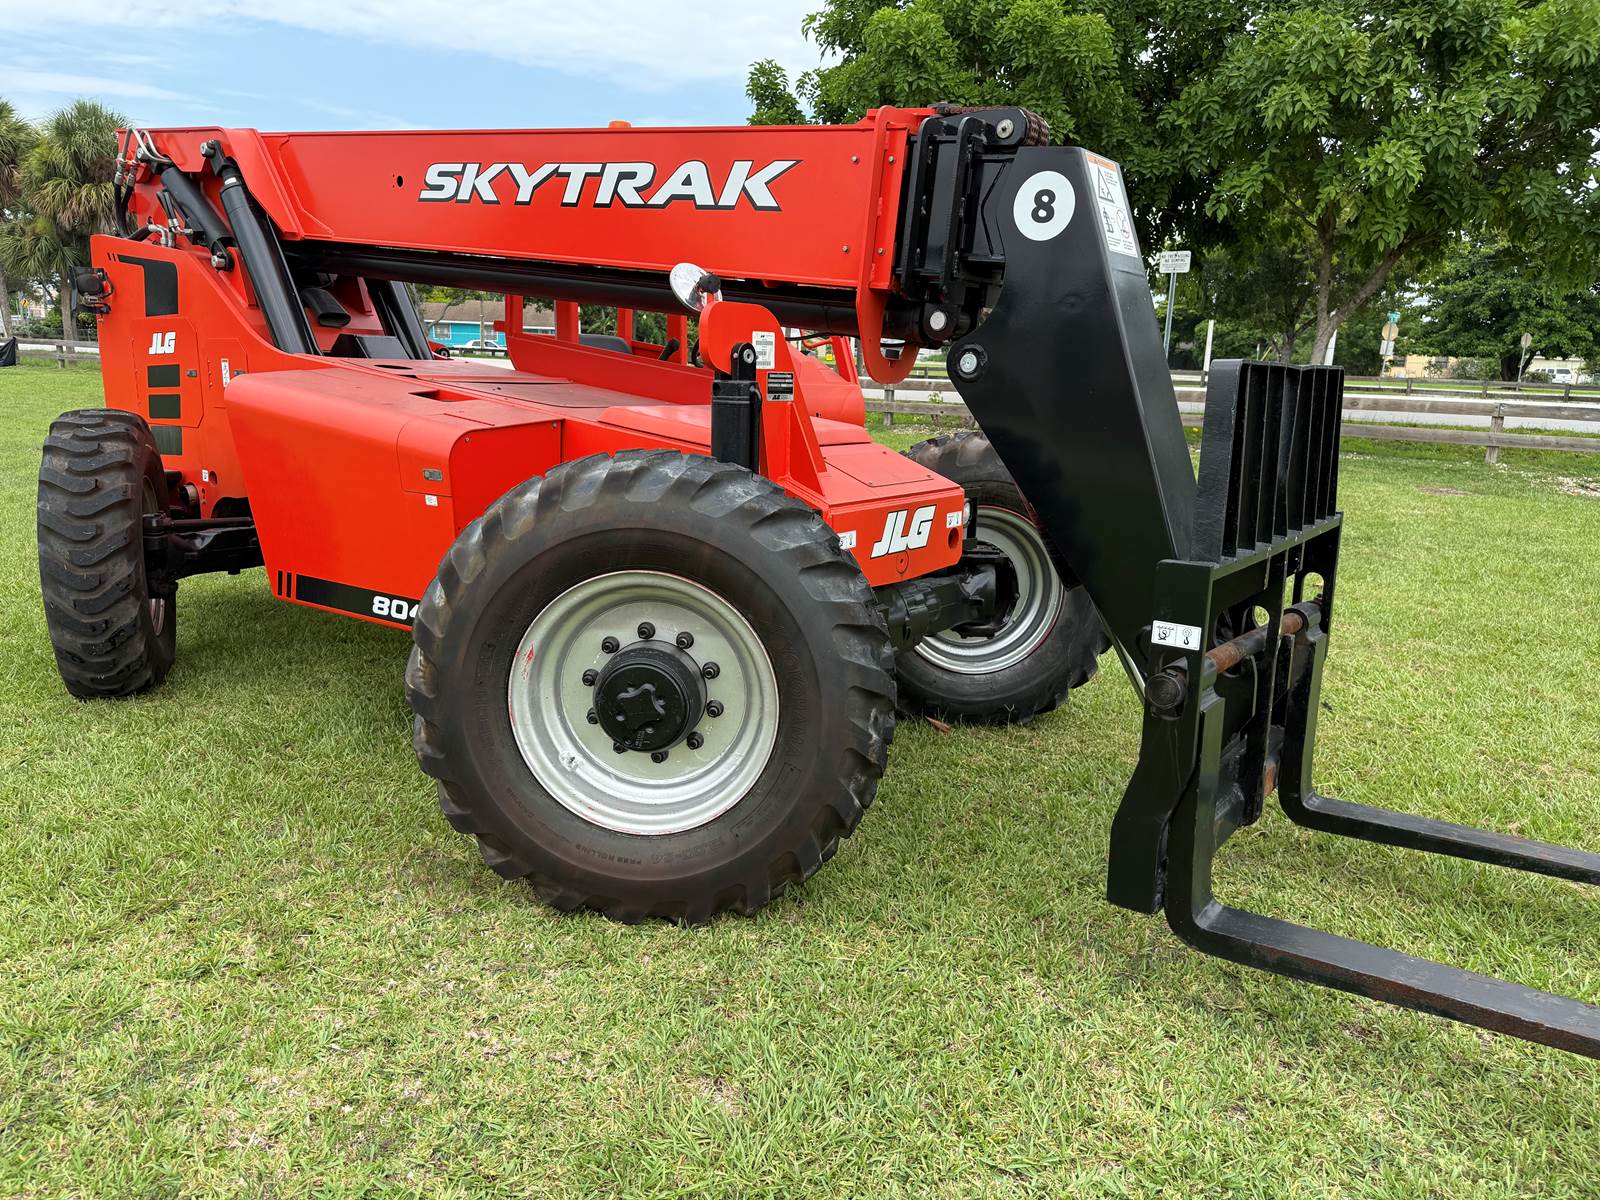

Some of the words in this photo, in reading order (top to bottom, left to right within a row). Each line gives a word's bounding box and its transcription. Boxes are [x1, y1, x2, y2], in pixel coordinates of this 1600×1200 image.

[417, 159, 803, 212] SKYTRAK
[1030, 188, 1057, 224] 8
[148, 331, 177, 355] JLG
[869, 503, 937, 559] JLG
